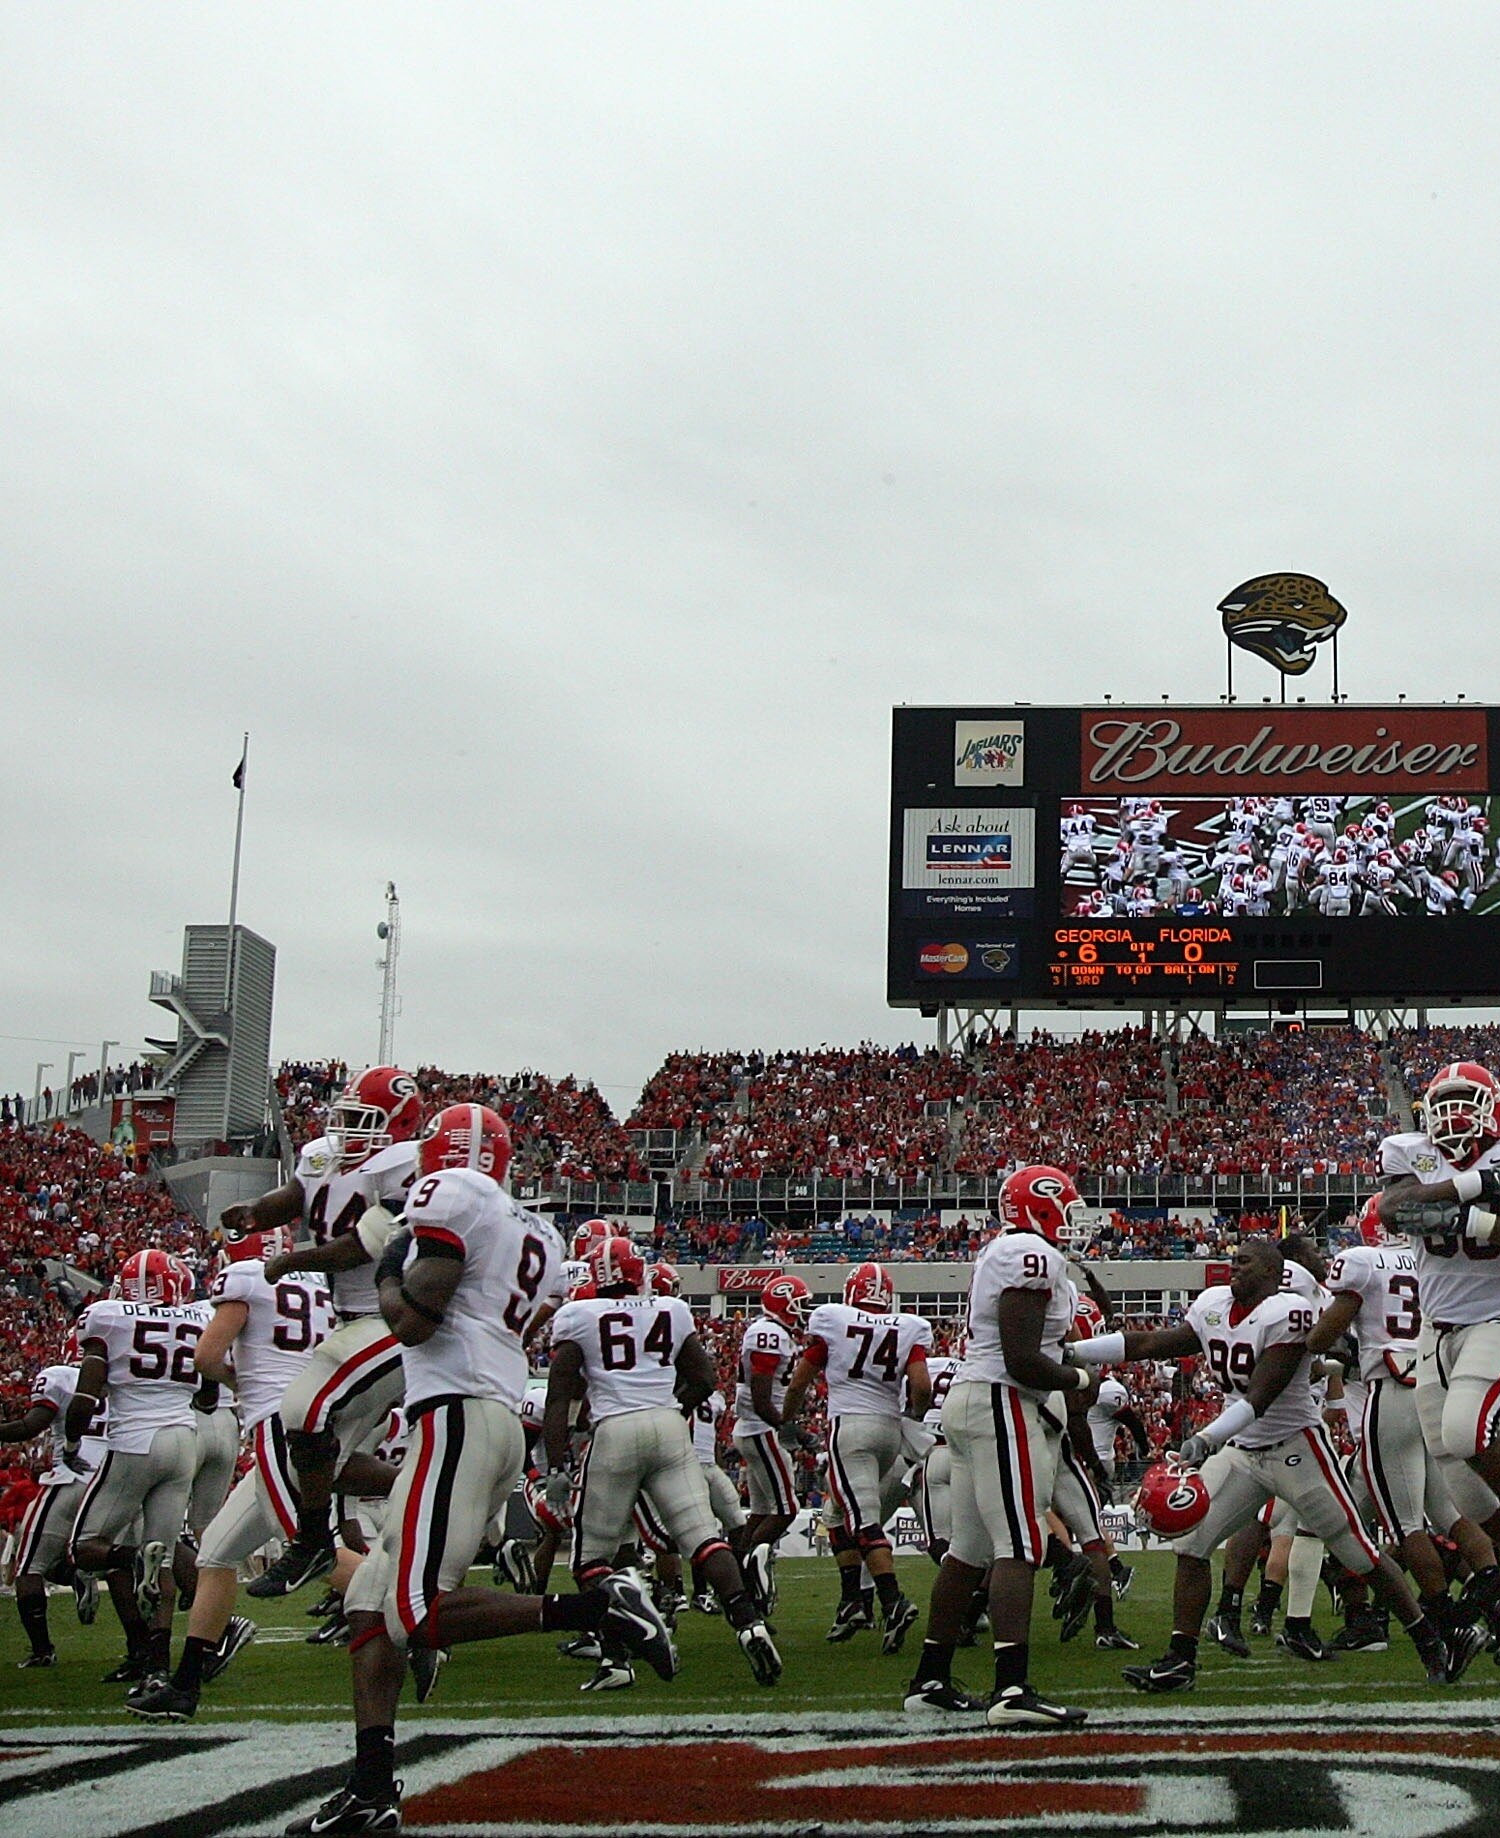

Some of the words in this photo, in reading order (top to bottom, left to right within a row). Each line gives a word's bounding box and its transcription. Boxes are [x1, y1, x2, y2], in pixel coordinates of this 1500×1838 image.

[957, 734, 1023, 766] JAGUARS
[1089, 719, 1478, 783] Budweiser
[930, 815, 962, 833] Ask
[966, 815, 1010, 833] about
[1070, 821, 1089, 835] 44
[931, 844, 1008, 853] LENNAR
[938, 873, 999, 885] lennar.com
[1329, 872, 1348, 886] 84
[1055, 929, 1132, 943] GEORGIA
[1160, 928, 1232, 942] FLORIDA
[920, 953, 967, 963] MasterCard
[1079, 943, 1097, 963] 6
[1130, 942, 1155, 951] QTR
[1184, 943, 1202, 962] 0
[1138, 952, 1146, 963] 1
[1071, 966, 1104, 975] DOWN
[1116, 965, 1131, 974] TO
[1136, 966, 1151, 974] GO
[1164, 965, 1195, 974] BALL
[1198, 965, 1215, 974] ON
[1053, 976, 1060, 986] 3
[1075, 975, 1100, 985] 3RD
[1131, 975, 1136, 985] 1
[1187, 975, 1192, 985] 1
[1227, 974, 1234, 985] 2
[480, 1152, 495, 1173] 9
[413, 1178, 440, 1208] 9
[1023, 1253, 1048, 1279] 91
[724, 1269, 776, 1289] Bud
[598, 1310, 674, 1372] 64
[757, 1332, 779, 1350] 83
[129, 1320, 203, 1384] 52
[846, 1325, 899, 1382] 74
